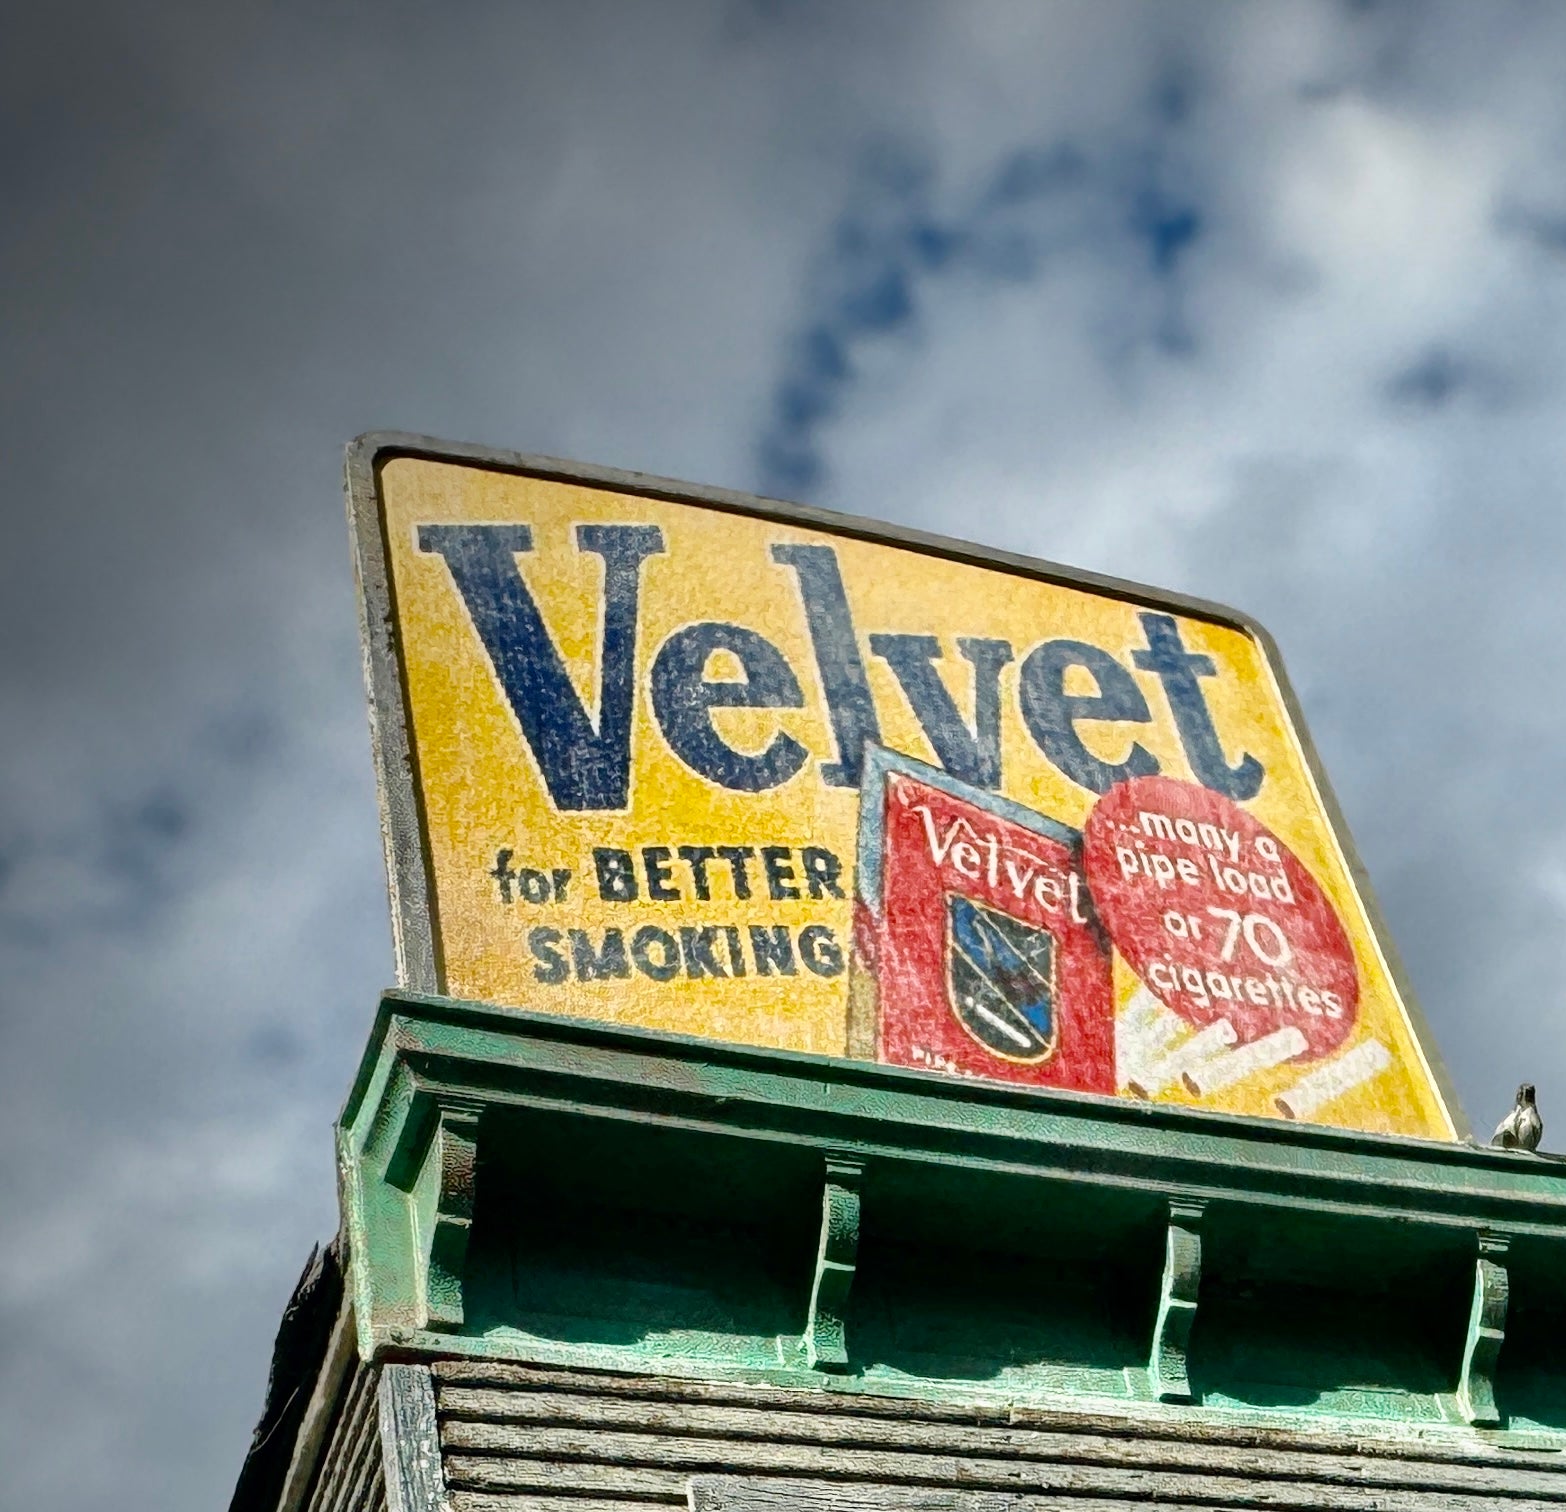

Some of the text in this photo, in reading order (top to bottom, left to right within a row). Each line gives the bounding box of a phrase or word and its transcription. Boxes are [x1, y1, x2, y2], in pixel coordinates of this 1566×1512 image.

[415, 523, 1264, 812] Velvet
[490, 847, 845, 904] for BETTER
[912, 806, 1087, 924] Velvet
[1116, 840, 1295, 905] pipe load
[1255, 836, 1281, 862] a
[528, 926, 842, 984] SMOKING
[1163, 906, 1293, 968] or 70
[1149, 953, 1344, 1018] cigarettes
